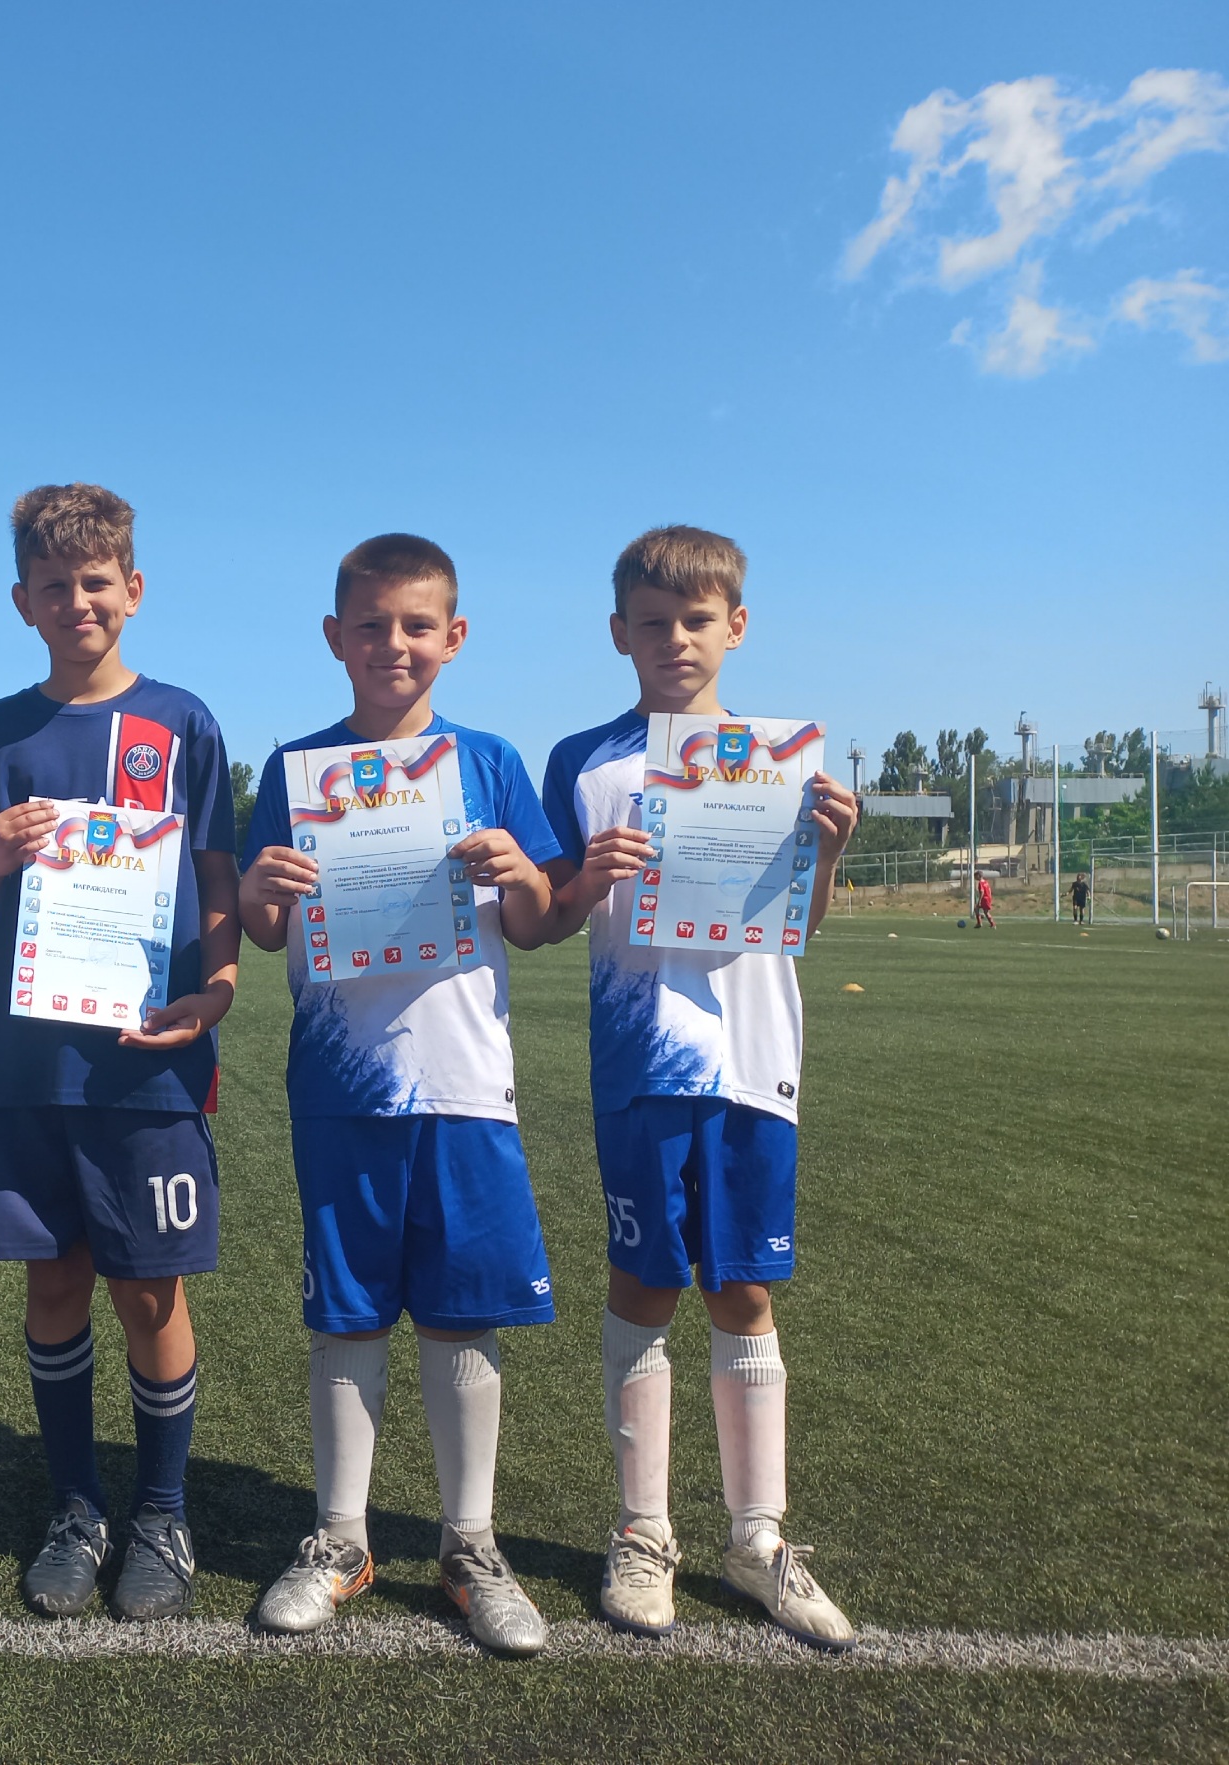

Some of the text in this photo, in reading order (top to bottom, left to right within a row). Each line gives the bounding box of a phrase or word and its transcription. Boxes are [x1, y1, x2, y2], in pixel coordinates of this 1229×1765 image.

[681, 765, 786, 786] ГРАМОТА
[325, 788, 426, 813] ГРАМОТА
[703, 802, 766, 813] НАГРАЖДАЕТСЯ
[349, 825, 410, 838] НАГРАЖДАЕТСЯ
[57, 847, 146, 872] ГРАМОТА
[72, 882, 127, 895] НАГРАЖДАЕТСЯ
[147, 1173, 198, 1233] 10
